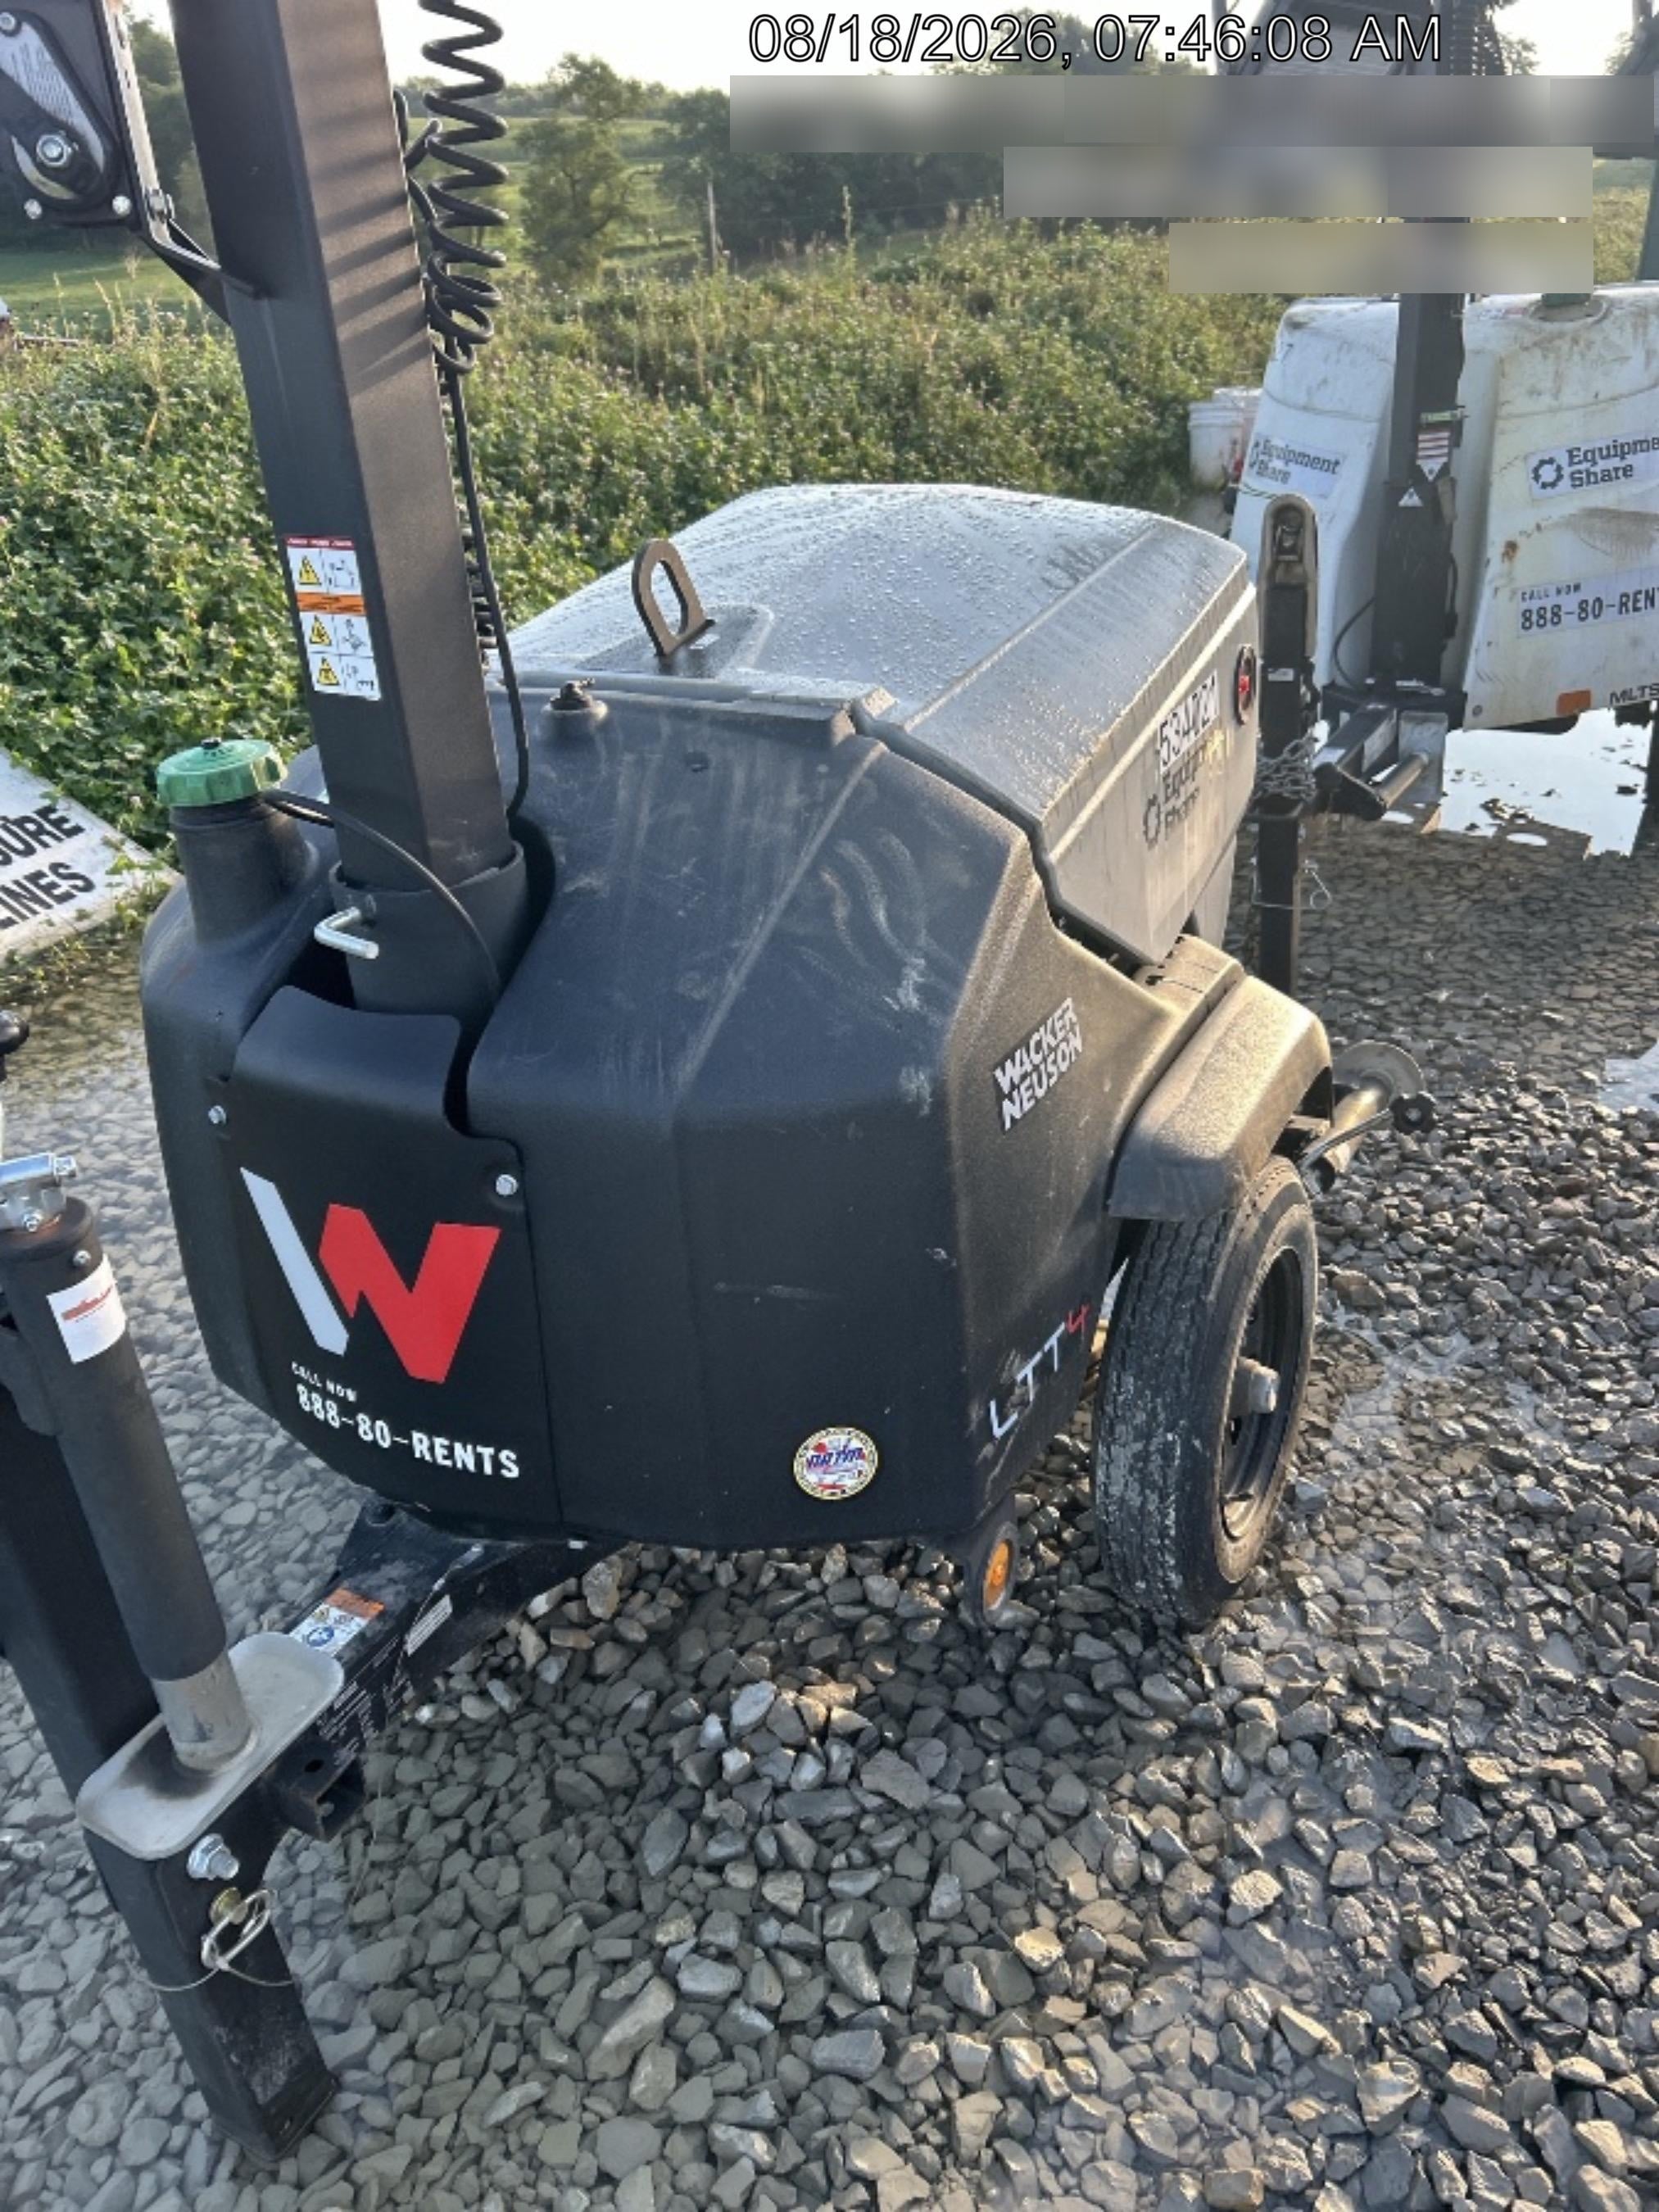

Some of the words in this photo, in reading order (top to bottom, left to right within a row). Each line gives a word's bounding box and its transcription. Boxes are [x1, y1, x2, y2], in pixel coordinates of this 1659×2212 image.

[1570, 464, 1633, 489] Share
[1521, 585, 1659, 631] 888-80-REN
[0, 805, 86, 866] URE
[0, 862, 96, 930] INES
[994, 997, 1077, 1095] WACKER
[1002, 1024, 1082, 1131] NEUSON
[292, 1361, 322, 1388] CALL
[326, 1379, 356, 1402] NOW
[297, 1383, 519, 1478] 888-80-RENTS
